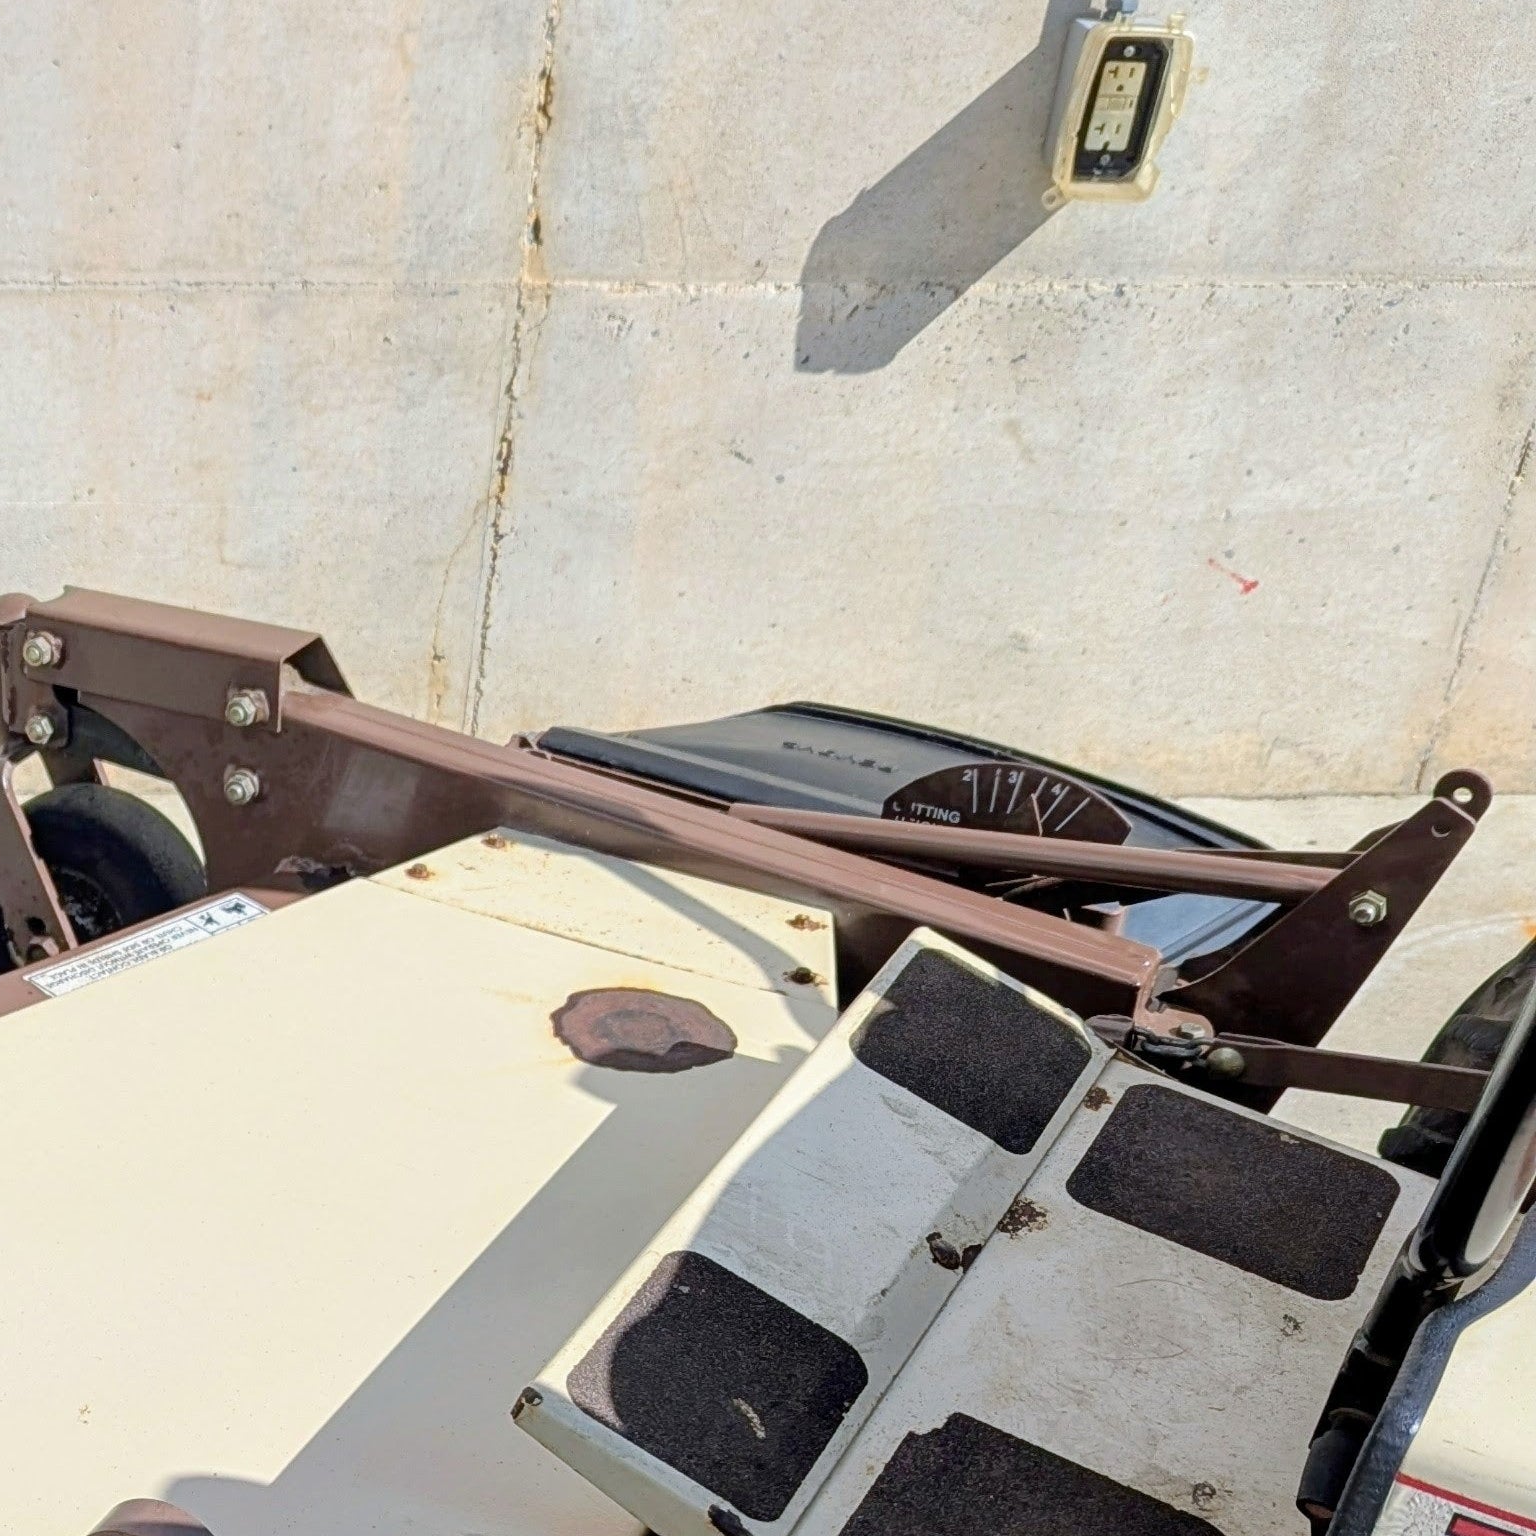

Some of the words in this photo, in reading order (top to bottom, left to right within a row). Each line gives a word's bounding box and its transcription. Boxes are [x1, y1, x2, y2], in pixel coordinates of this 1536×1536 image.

[962, 769, 971, 782] 2
[1008, 772, 1017, 784] 3
[1051, 783, 1061, 795] 4
